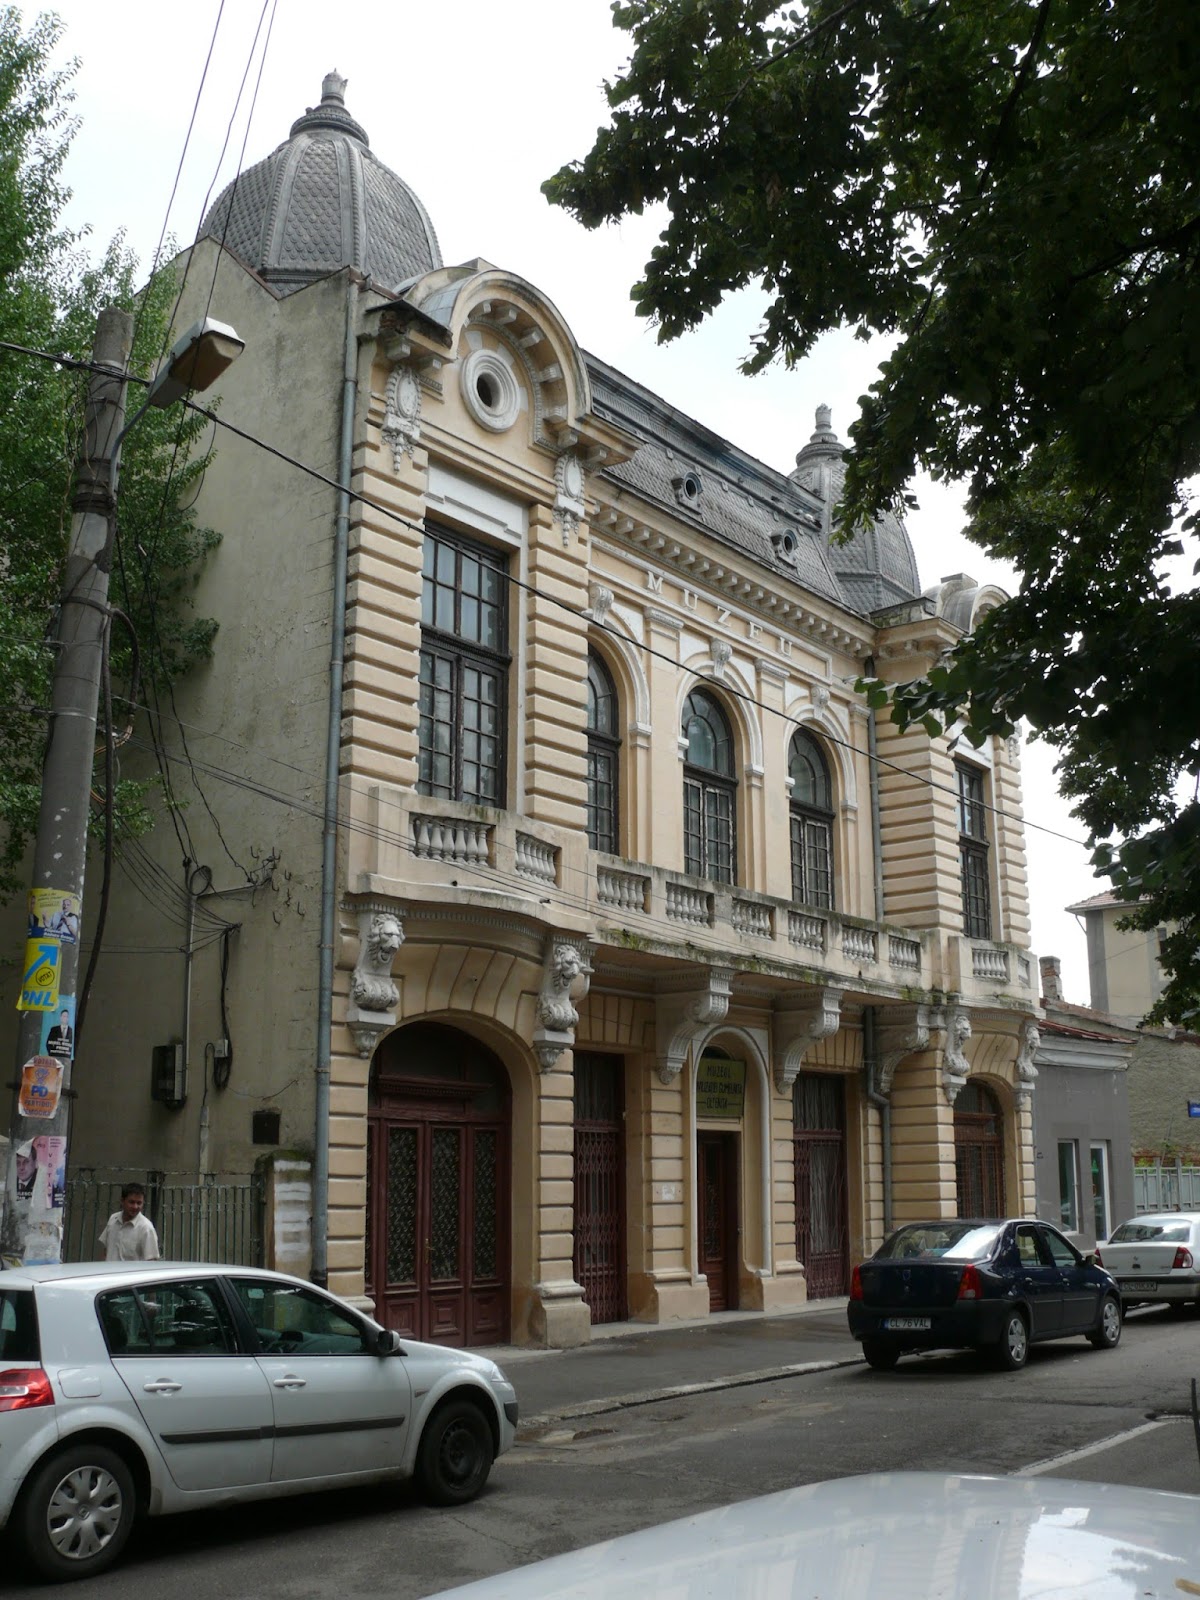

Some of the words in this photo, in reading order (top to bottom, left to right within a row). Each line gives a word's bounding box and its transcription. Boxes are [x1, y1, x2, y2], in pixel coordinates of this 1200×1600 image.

[647, 571, 793, 657] MUZEU
[23, 990, 54, 1006] PNL
[31, 1085, 49, 1097] PD
[890, 1319, 901, 1328] CL
[914, 1319, 929, 1328] VAL
